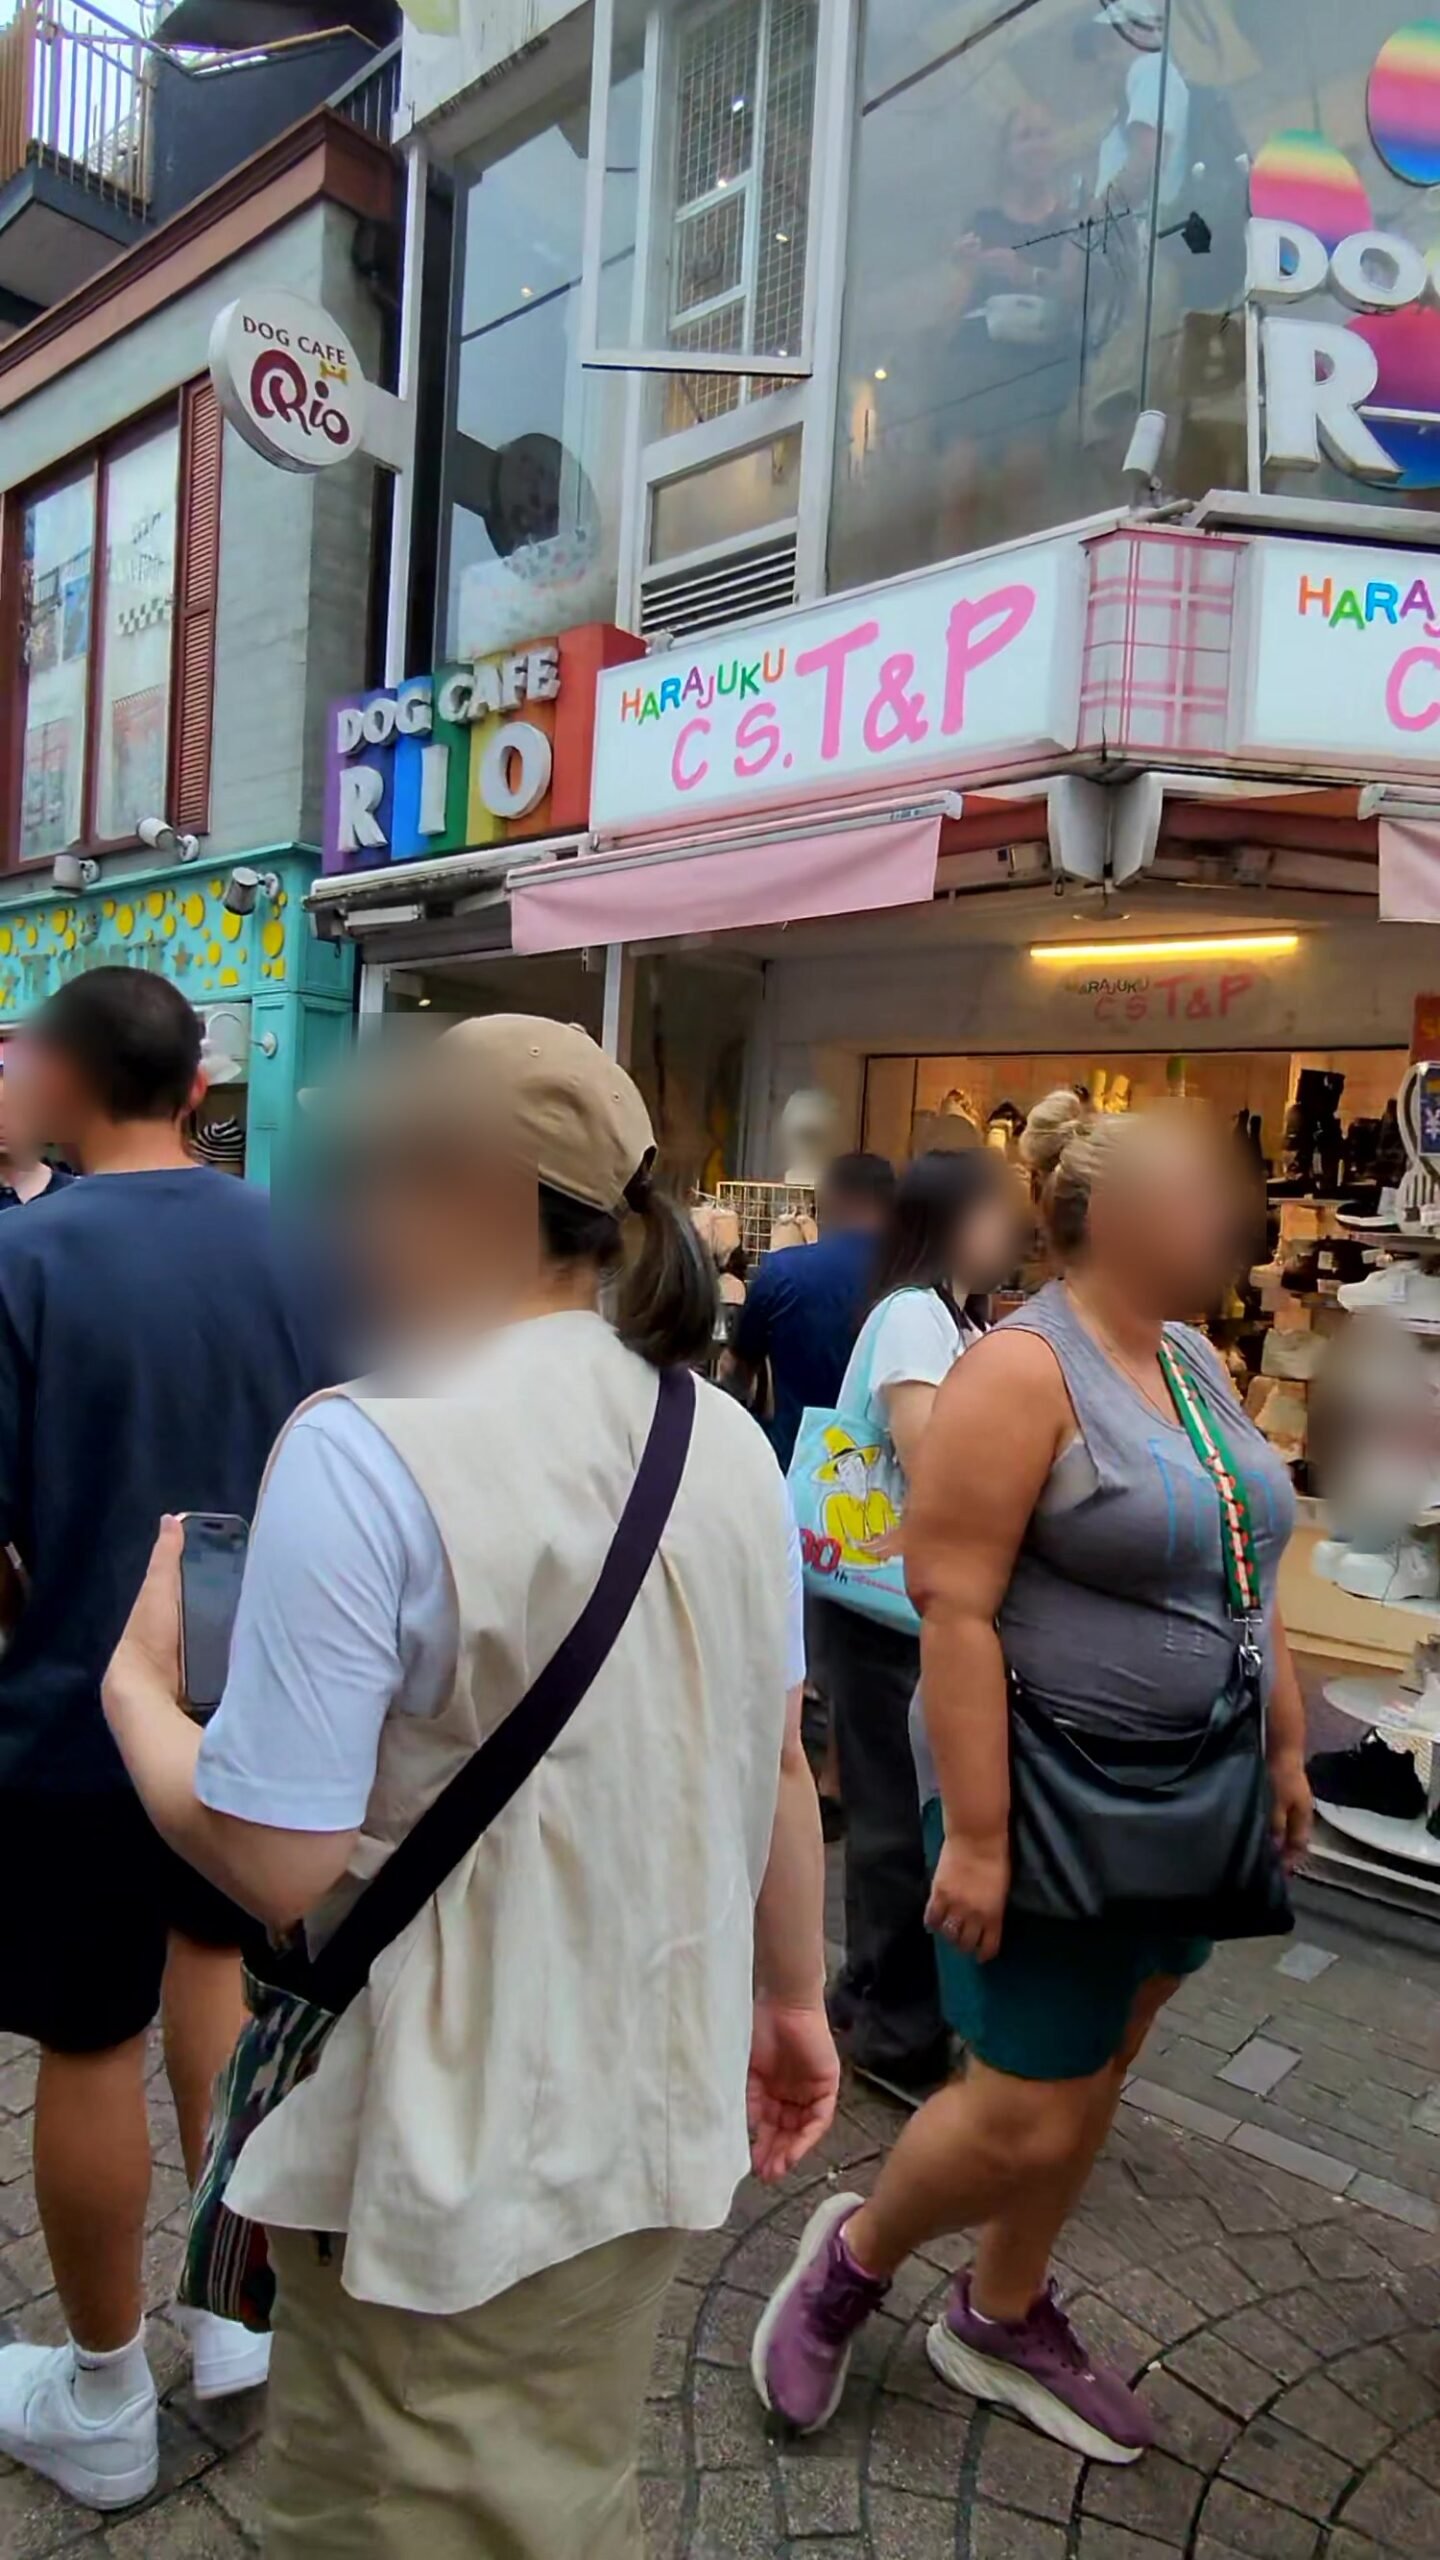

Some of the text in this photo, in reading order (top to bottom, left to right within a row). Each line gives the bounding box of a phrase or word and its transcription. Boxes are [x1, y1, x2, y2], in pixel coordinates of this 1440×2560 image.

[1245, 216, 1440, 315] DO
[242, 315, 348, 366] DOG CAFE
[250, 349, 350, 445] Rio
[337, 645, 561, 756] DOG CAFE
[620, 648, 786, 726] HARAJUKU
[794, 584, 1037, 761] T&P
[337, 721, 553, 852] RIO
[1154, 970, 1255, 1021] T&P
